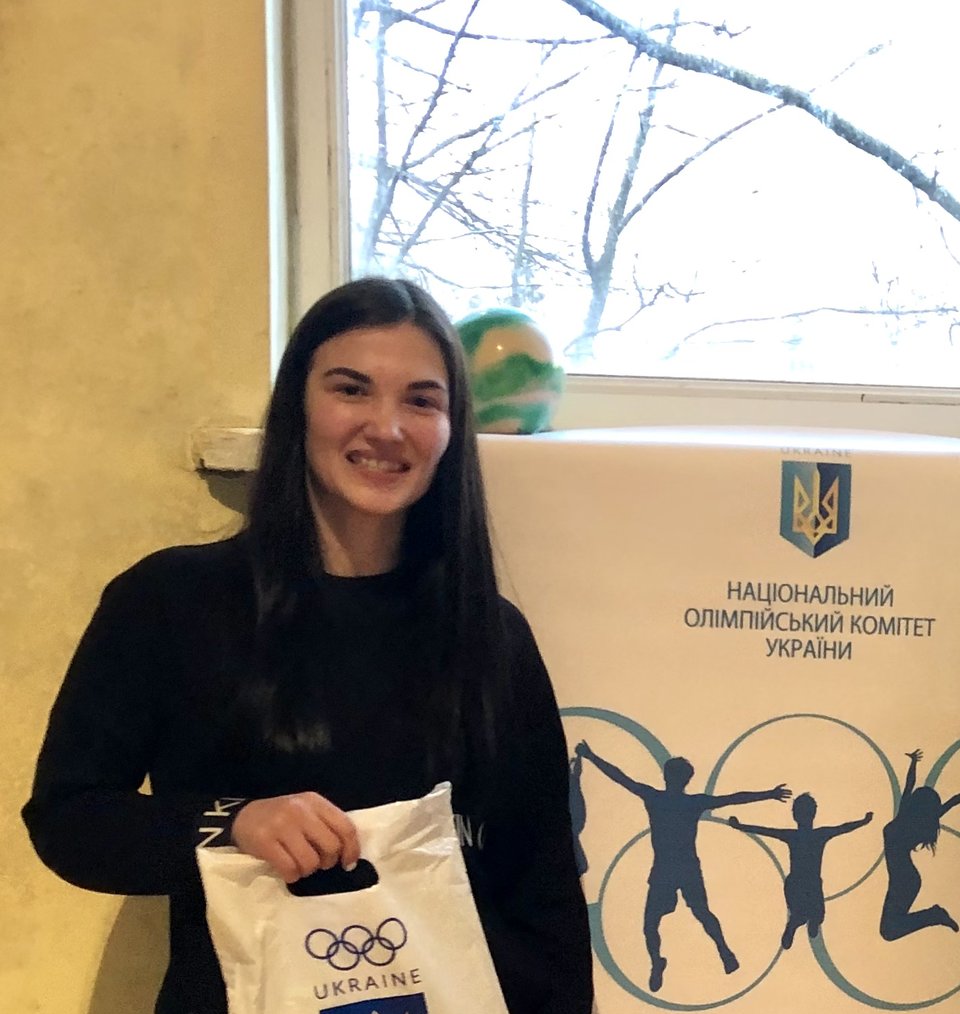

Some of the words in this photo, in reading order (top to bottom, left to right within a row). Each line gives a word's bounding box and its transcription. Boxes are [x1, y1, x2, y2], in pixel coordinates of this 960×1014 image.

[727, 581, 895, 607] НАЦІОНАЛЬНИЙ
[684, 607, 844, 634] ОЛІМПІЙСЬКИЙ
[849, 615, 936, 637] КОМІТЕТ
[765, 637, 853, 660] УКРАЇНИ
[313, 967, 424, 1000] UKRAINE
